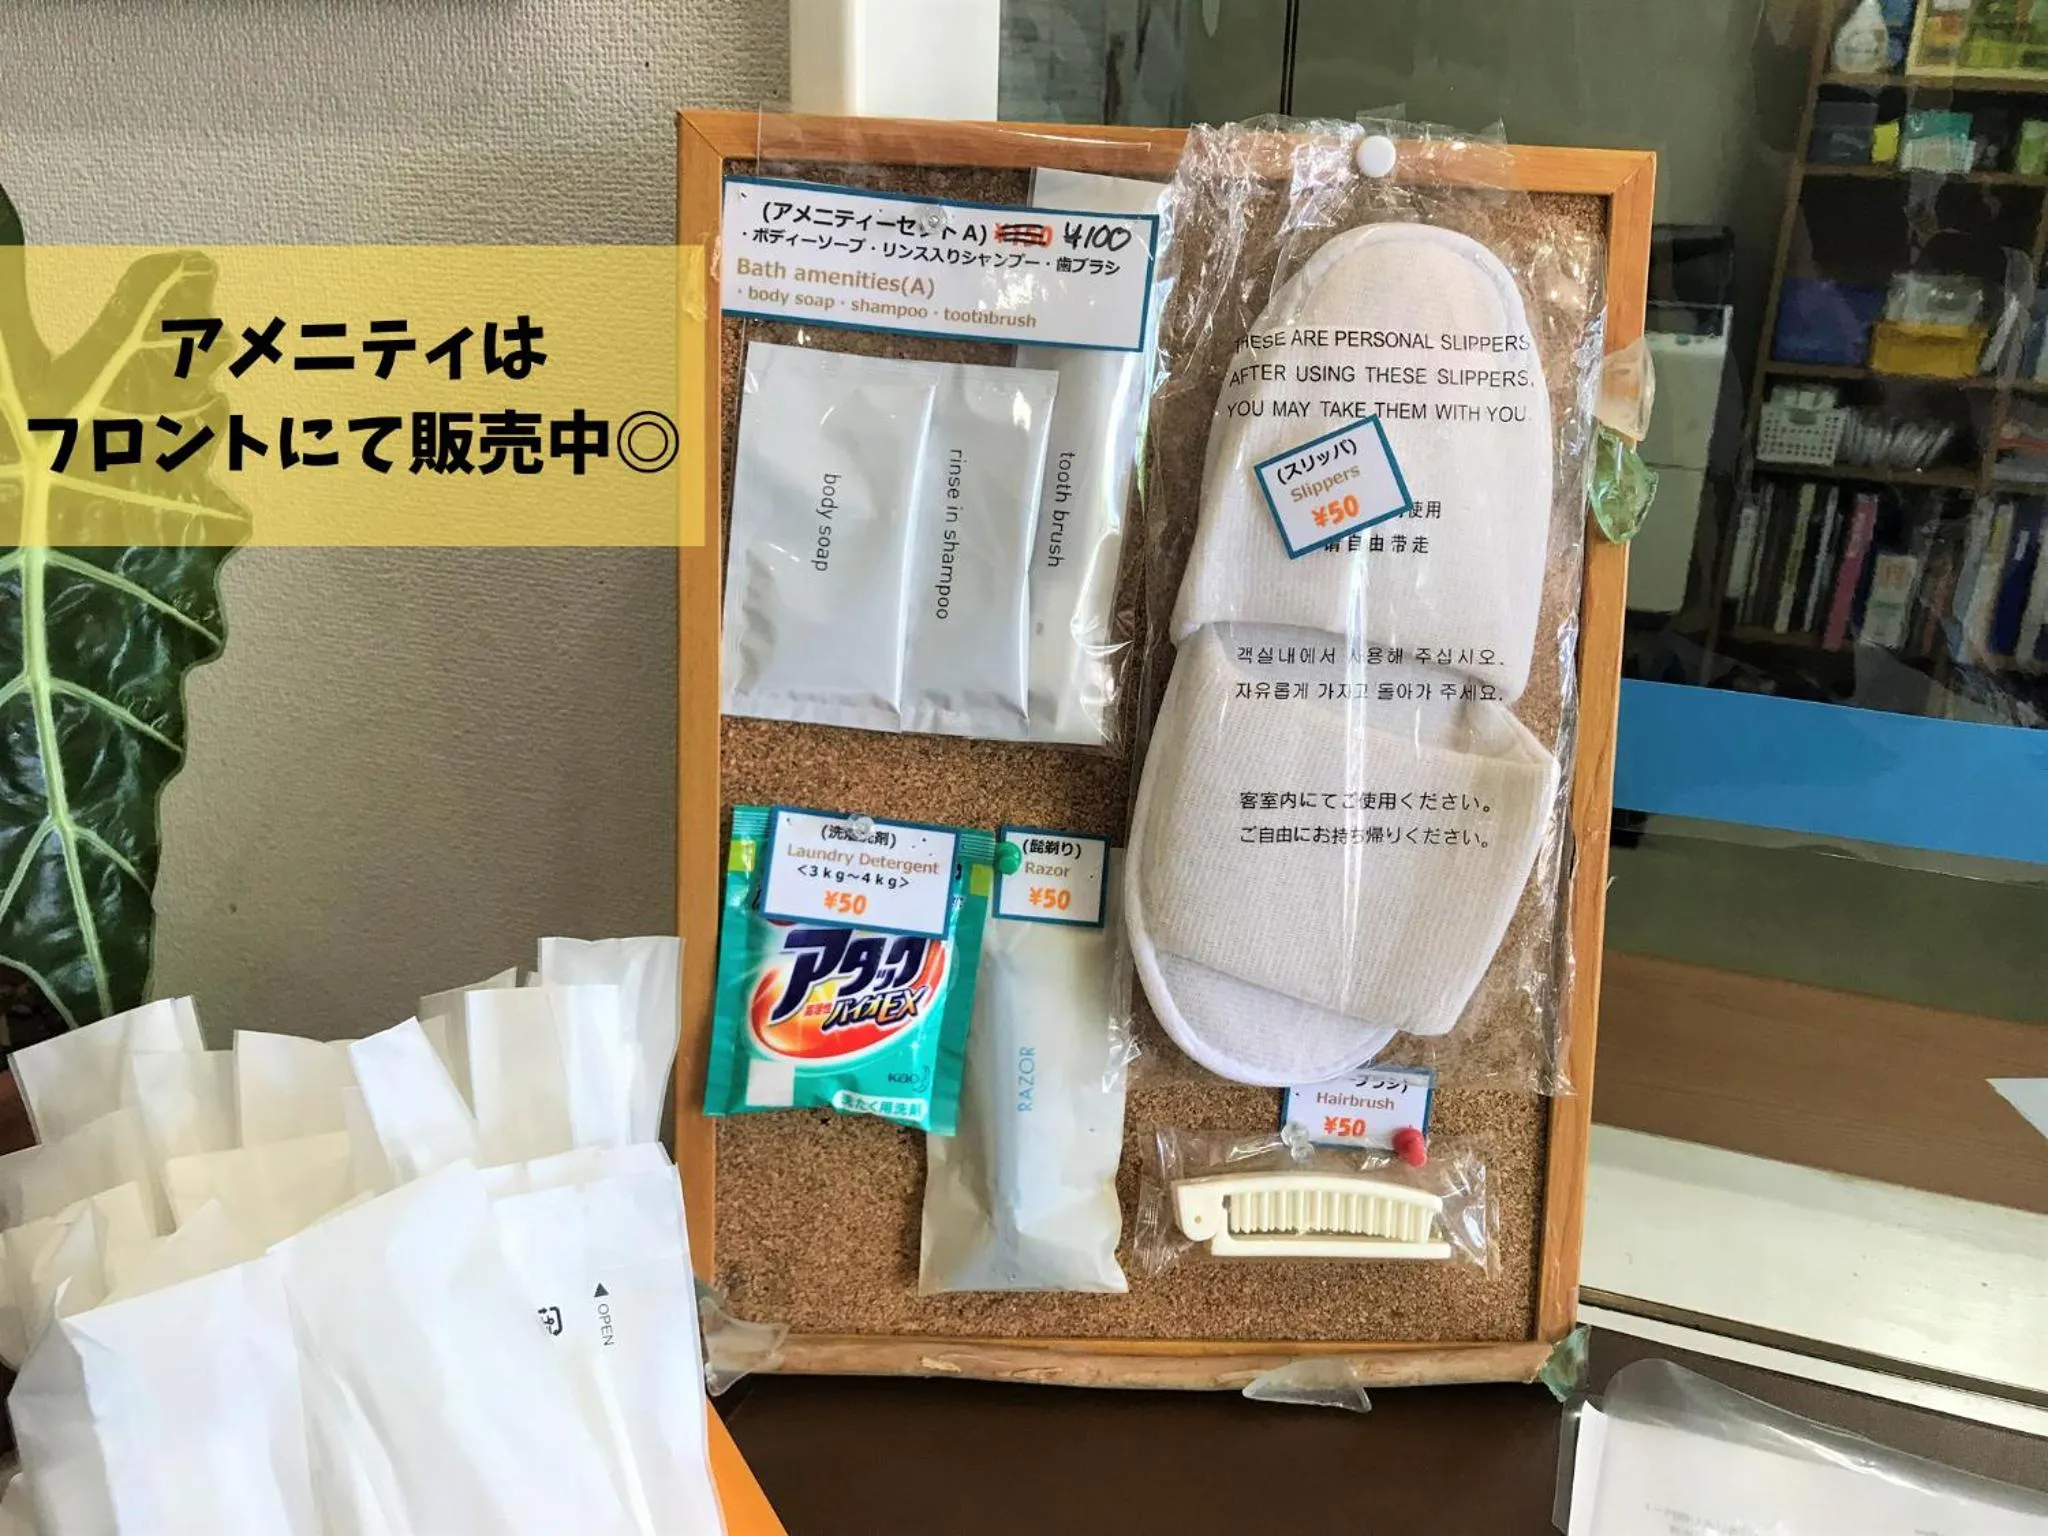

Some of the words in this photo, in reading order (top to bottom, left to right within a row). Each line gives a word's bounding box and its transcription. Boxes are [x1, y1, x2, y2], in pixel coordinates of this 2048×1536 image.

[737, 257, 787, 280] Bath
[794, 265, 935, 300] amenities(A)
[748, 286, 790, 306] body
[795, 294, 835, 311] soap
[851, 299, 929, 319] shampoo
[944, 307, 1037, 329] toothbrush
[1291, 329, 1329, 347] ARE
[1335, 330, 1434, 349] PERSONAL
[1440, 334, 1531, 352] SLIPPERS
[1229, 364, 1287, 387] AFTER
[1296, 365, 1356, 382] USING
[1365, 366, 1428, 385] THESE
[1227, 400, 1265, 418] YOU
[1273, 401, 1312, 417] MAY
[1320, 401, 1367, 418] TAKE
[1374, 402, 1427, 419] THEM
[1435, 404, 1481, 421] WITH
[947, 449, 967, 499] rinse
[1055, 452, 1076, 503] tooth
[1277, 438, 1358, 486] (スリッパ)
[816, 473, 842, 520] body
[1290, 465, 1361, 503] Slippers
[945, 506, 964, 523] in
[1311, 493, 1360, 529] ¥50
[811, 525, 832, 572] soap
[1048, 509, 1071, 568] brush
[935, 530, 960, 620] shampoo
[1237, 646, 1336, 664] 객실내에서
[1415, 647, 1505, 665] 주십시오.
[1377, 683, 1432, 701] 돌아가
[1440, 683, 1503, 702] 주세요.
[1240, 791, 1490, 813] 客室内にてご使用ください。
[1240, 825, 1488, 848] ご自由にお持ち帰りください。
[787, 843, 854, 865] Laundry
[859, 851, 940, 876] Detergent
[1025, 861, 1071, 878] Razor
[823, 889, 868, 916] ¥50
[1029, 885, 1072, 911] ¥50
[771, 929, 927, 1021] アタック
[1017, 1047, 1036, 1111] RAZOR
[1316, 1090, 1396, 1111] Hairbrush
[1323, 1115, 1367, 1138] ¥50
[598, 1303, 616, 1346] OPEN
